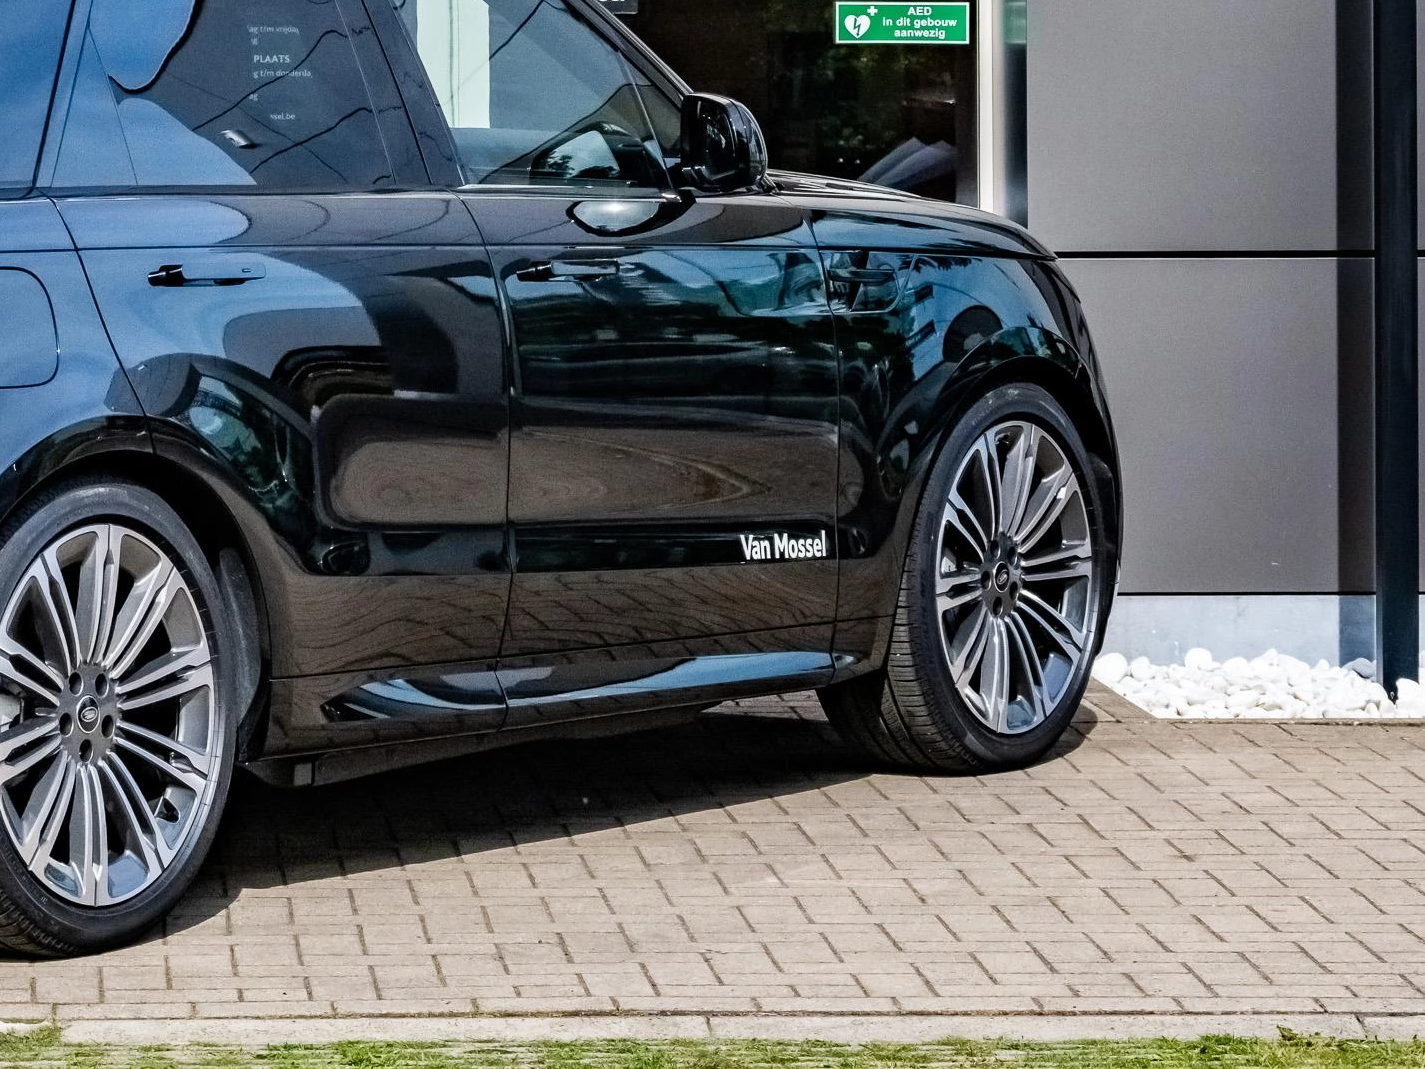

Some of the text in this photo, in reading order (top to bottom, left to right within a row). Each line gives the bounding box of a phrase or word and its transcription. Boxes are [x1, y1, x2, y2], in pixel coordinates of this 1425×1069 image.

[907, 6, 932, 16] AED
[896, 17, 911, 27] dit
[913, 17, 958, 29] gebouw
[894, 28, 946, 39] aanwezig
[739, 530, 827, 560] Van Mossel
